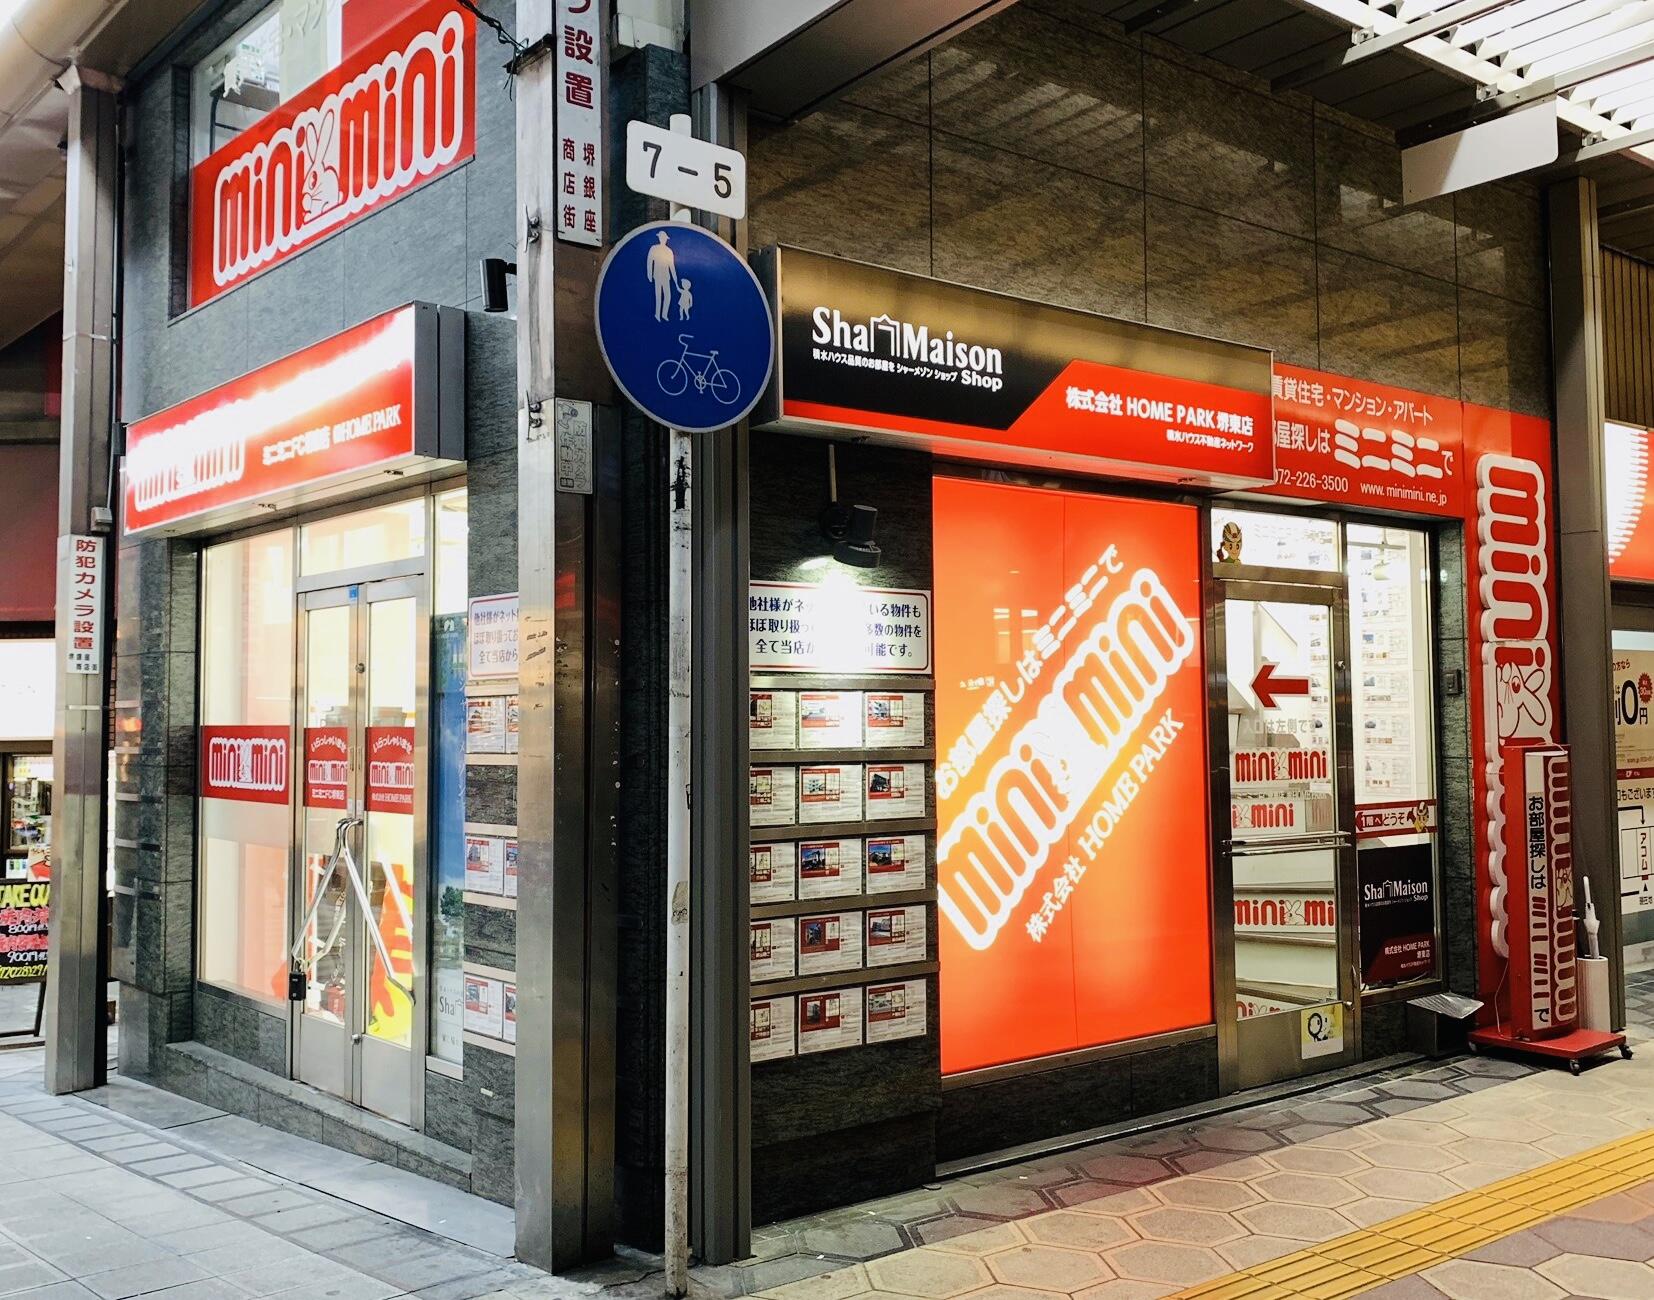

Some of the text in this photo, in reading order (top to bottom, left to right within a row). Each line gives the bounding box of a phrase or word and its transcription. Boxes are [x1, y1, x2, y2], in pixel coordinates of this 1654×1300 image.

[213, 10, 464, 286] mini mini
[562, 137, 576, 229] 商店街
[583, 143, 596, 233] 堺銀座
[812, 306, 1003, 375] Sha Maison
[961, 370, 1003, 392] Shop
[1066, 386, 1254, 437] 株式会社 HOME PARK 堺東店
[1360, 481, 1447, 506] www.minimini.ne.jp
[74, 539, 96, 650] 防犯カメラ設置
[252, 738, 286, 791] mini
[1077, 771, 1139, 861] HOME
[1128, 707, 1185, 784] PARK
[1235, 750, 1327, 782] mini mini
[1250, 803, 1294, 828] mini
[1234, 900, 1286, 926] mini
[1364, 880, 1428, 901] Sha Maison
